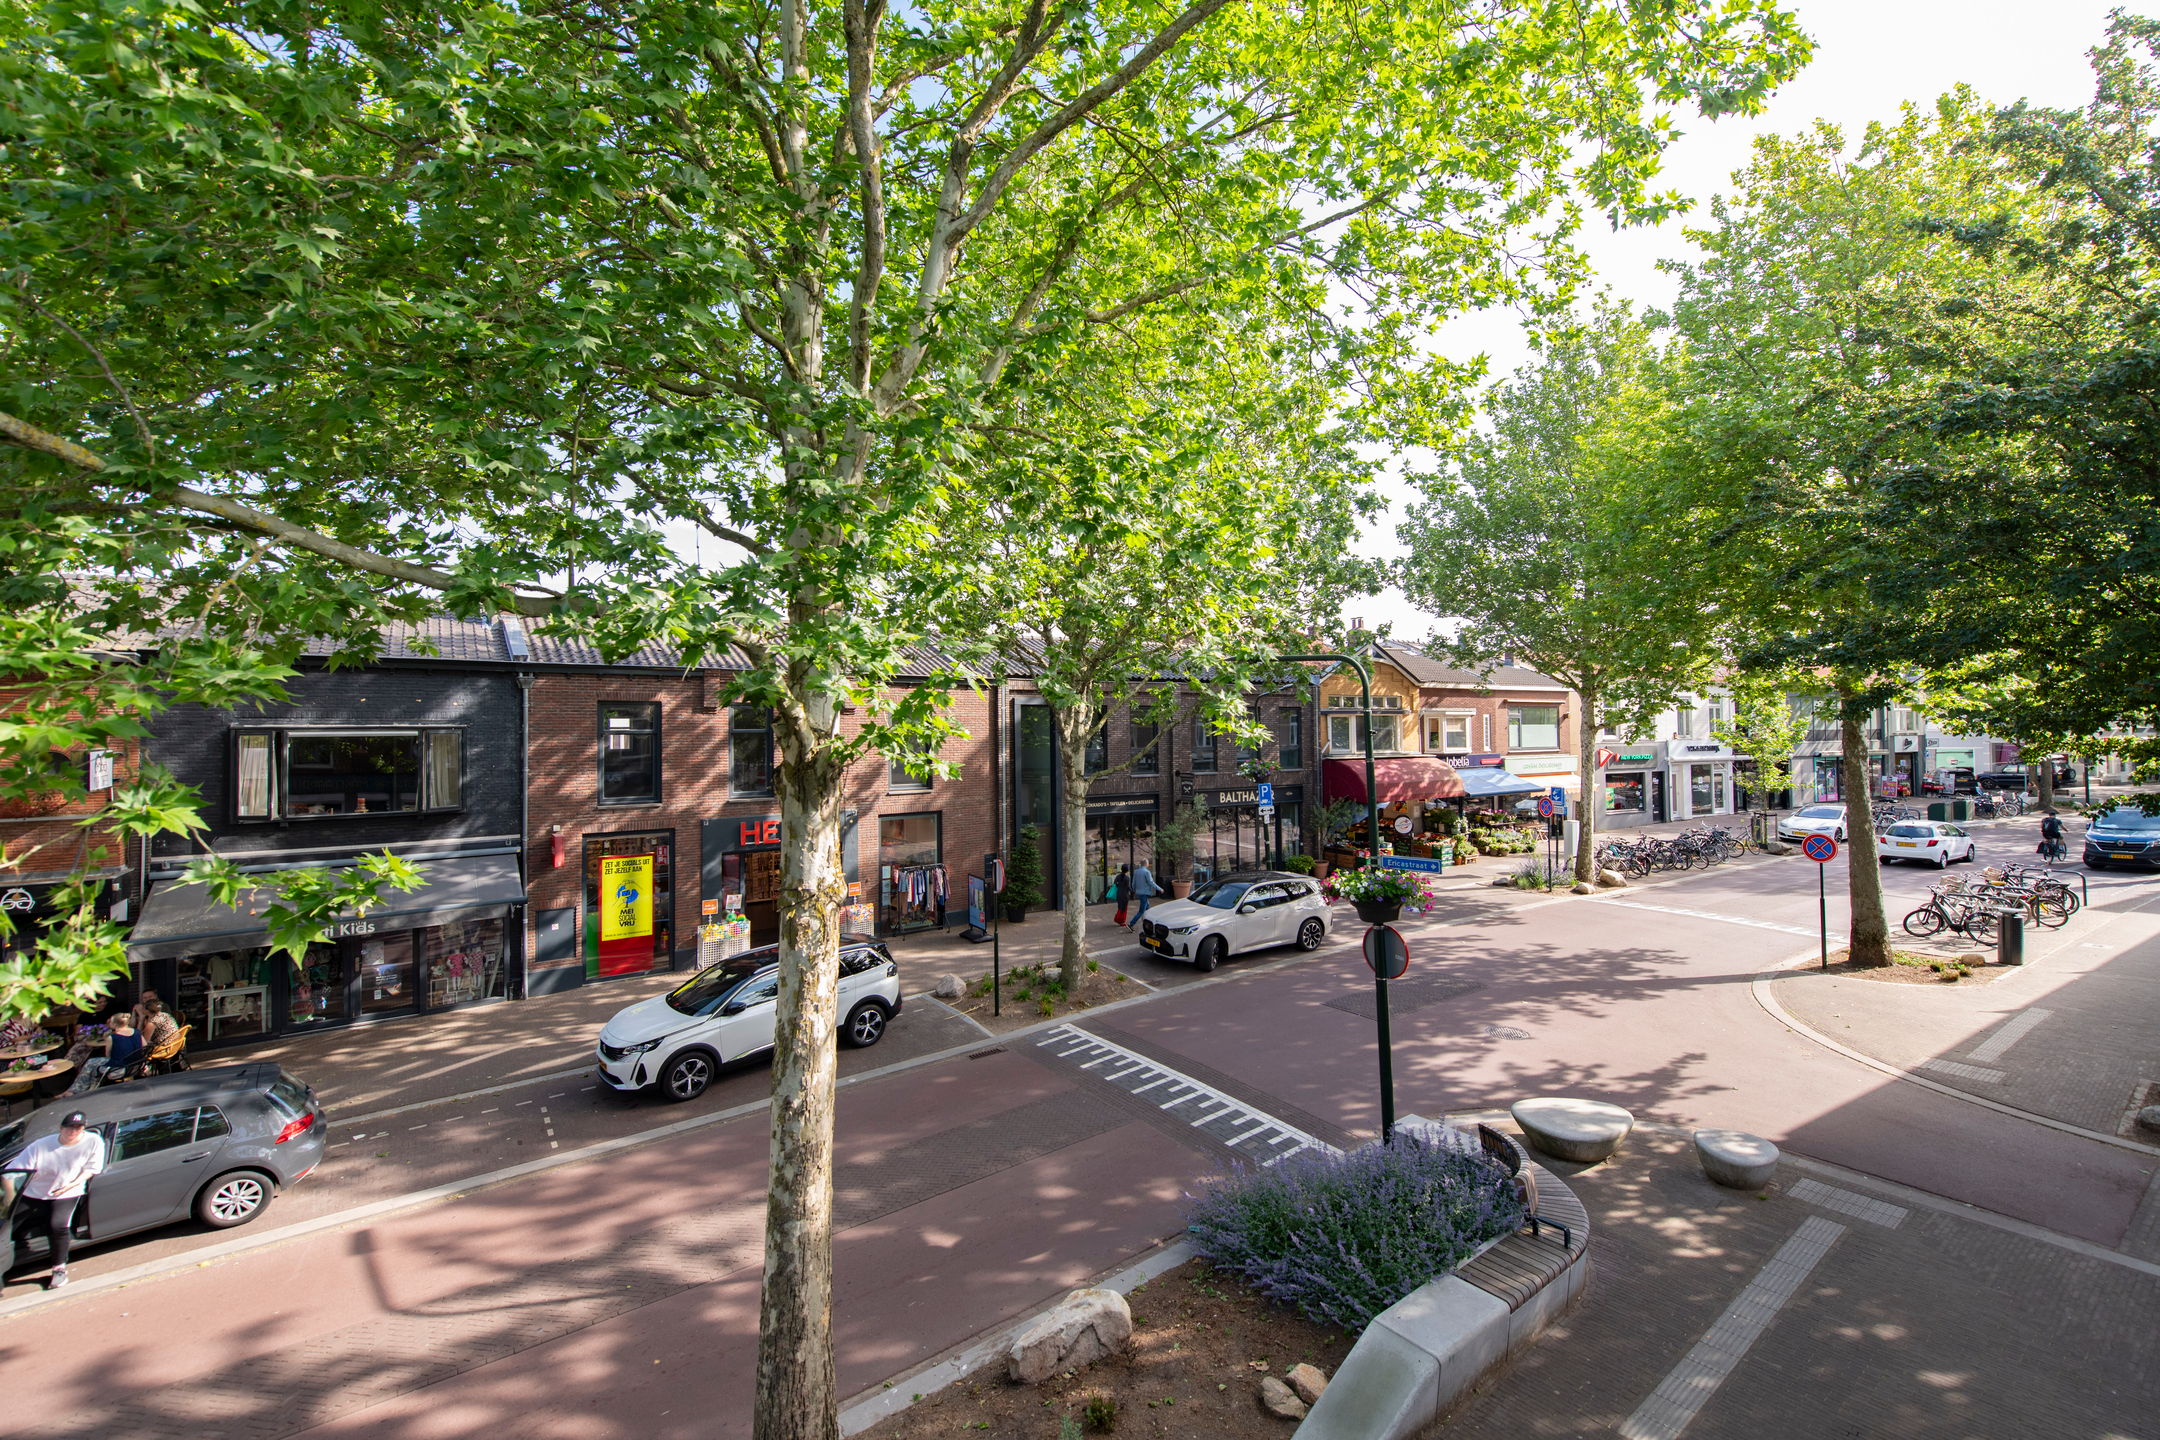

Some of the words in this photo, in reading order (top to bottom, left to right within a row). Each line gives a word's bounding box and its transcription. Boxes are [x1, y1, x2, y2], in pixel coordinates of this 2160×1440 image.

[1261, 785, 1268, 798] P
[740, 820, 781, 846] HE
[1387, 859, 1427, 869] Ericastraat
[340, 921, 375, 936] Kids
